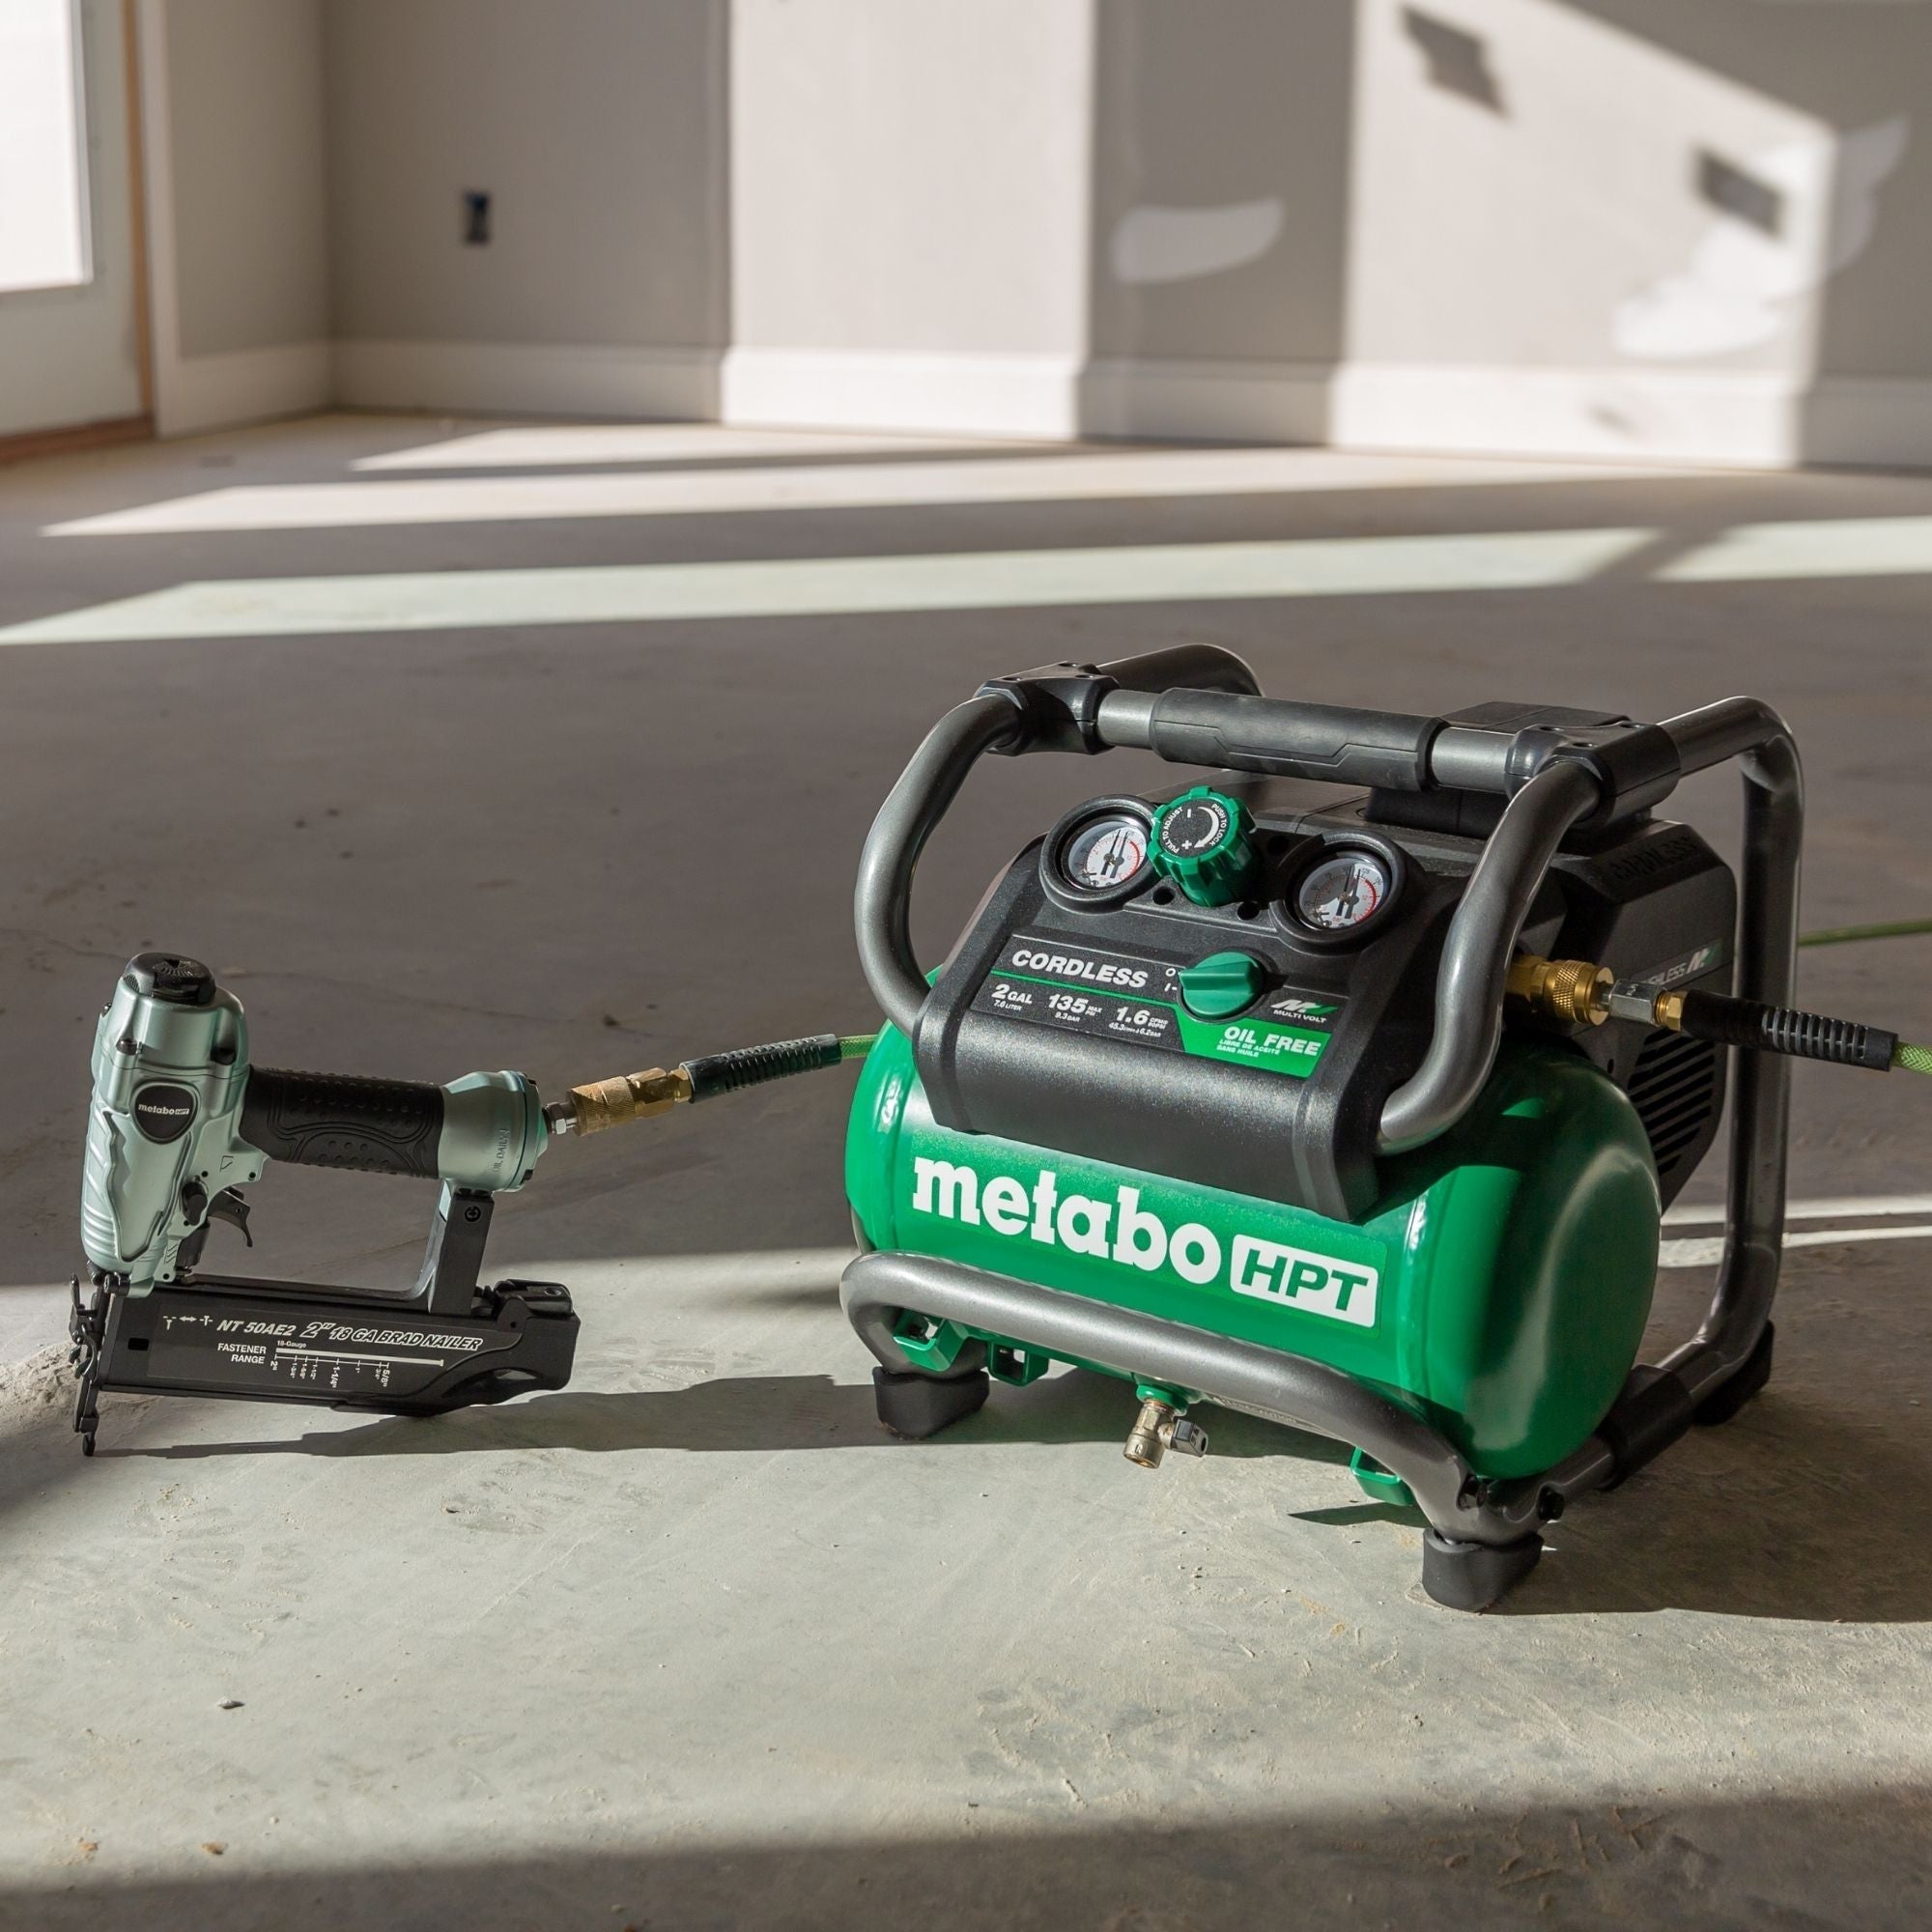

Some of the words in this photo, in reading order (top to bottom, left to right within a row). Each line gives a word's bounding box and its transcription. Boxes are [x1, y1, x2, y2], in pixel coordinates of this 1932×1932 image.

[1163, 806, 1183, 830] ADJUST
[1211, 804, 1226, 819] PUSH
[1220, 819, 1227, 828] TO
[1209, 829, 1225, 846] LOCK
[1165, 839, 1179, 853] PULL
[1012, 950, 1149, 988] CORDLESS
[1048, 993, 1089, 1013] 135
[1117, 1007, 1151, 1025] 1.6
[1273, 1009, 1301, 1019] MULTI
[1302, 1014, 1326, 1023] VOLT
[1224, 1026, 1256, 1044] OIL
[1264, 1034, 1321, 1056] FREE
[139, 1104, 174, 1115] metabo
[912, 1156, 1221, 1285] metabo
[1240, 1248, 1369, 1312] HPT
[216, 1320, 244, 1331] NT
[243, 1321, 297, 1336] 50AE2
[328, 1326, 354, 1341] 18
[351, 1328, 378, 1343] GA
[374, 1330, 424, 1346] BRAD
[420, 1334, 483, 1351] NAILER
[217, 1343, 267, 1354] FASTENER
[277, 1340, 306, 1349] 18-Gauge
[231, 1354, 265, 1364] RANGE
